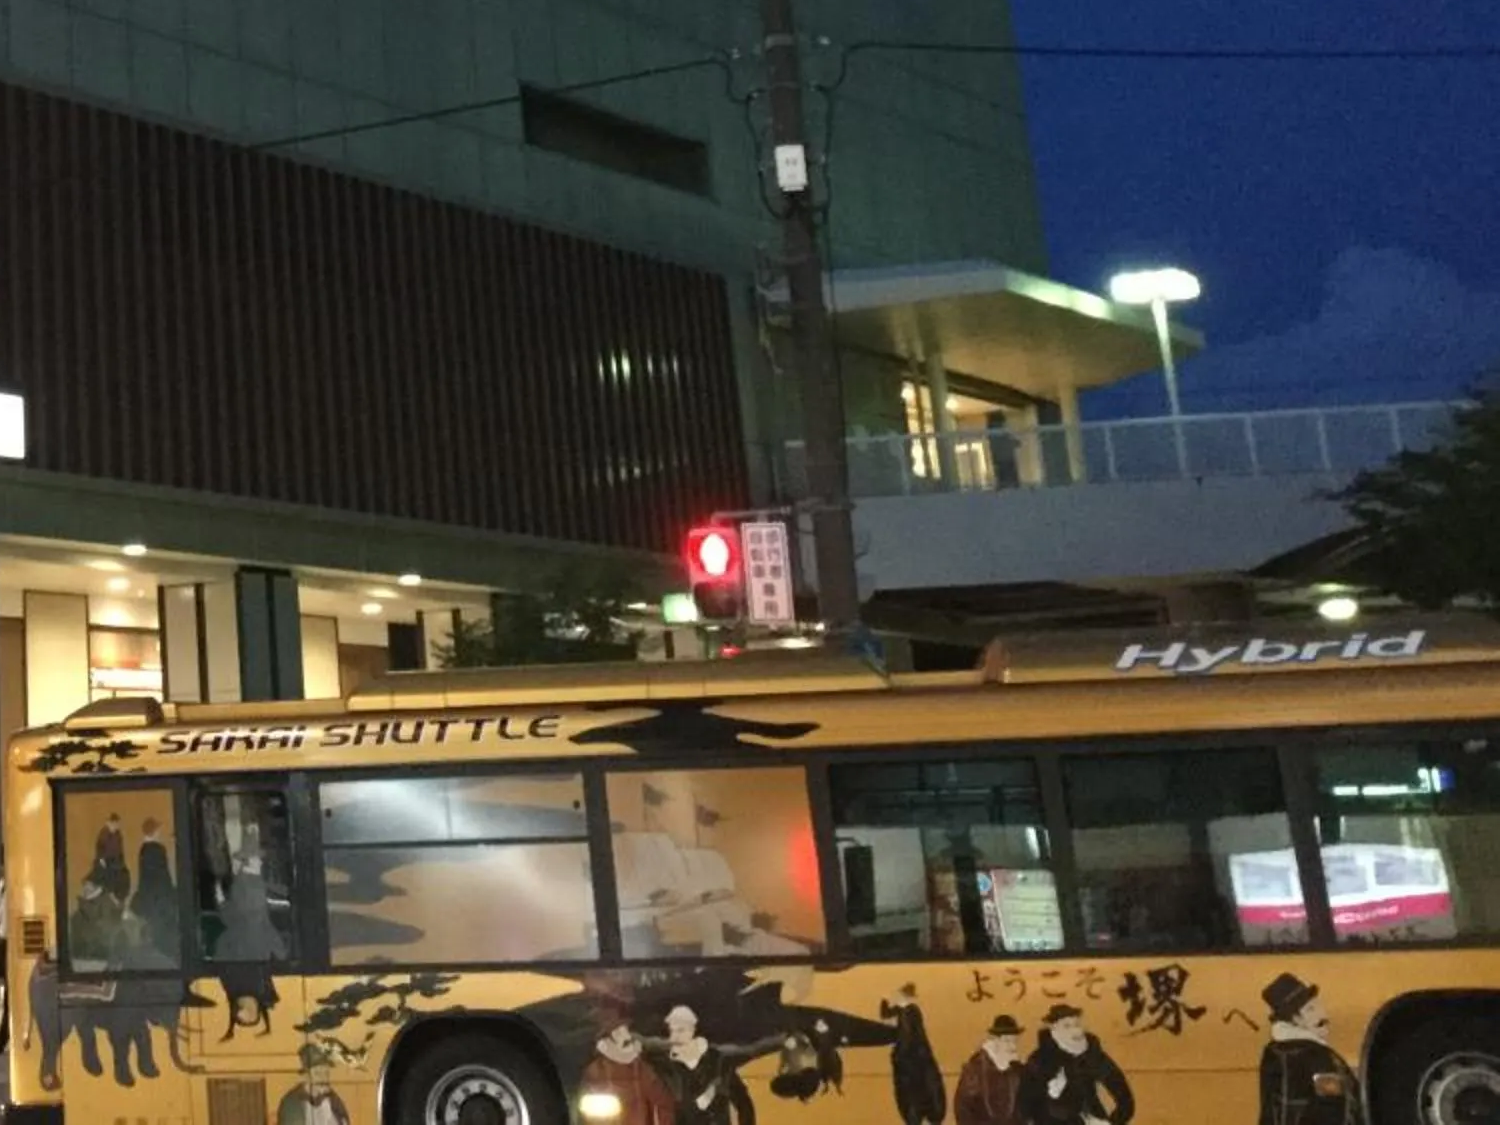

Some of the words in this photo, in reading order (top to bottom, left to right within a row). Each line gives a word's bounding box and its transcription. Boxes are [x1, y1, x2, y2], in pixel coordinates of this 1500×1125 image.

[1113, 630, 1426, 672] Hybrid
[156, 724, 307, 754] SAKAI
[319, 714, 562, 747] SHUTTLE
